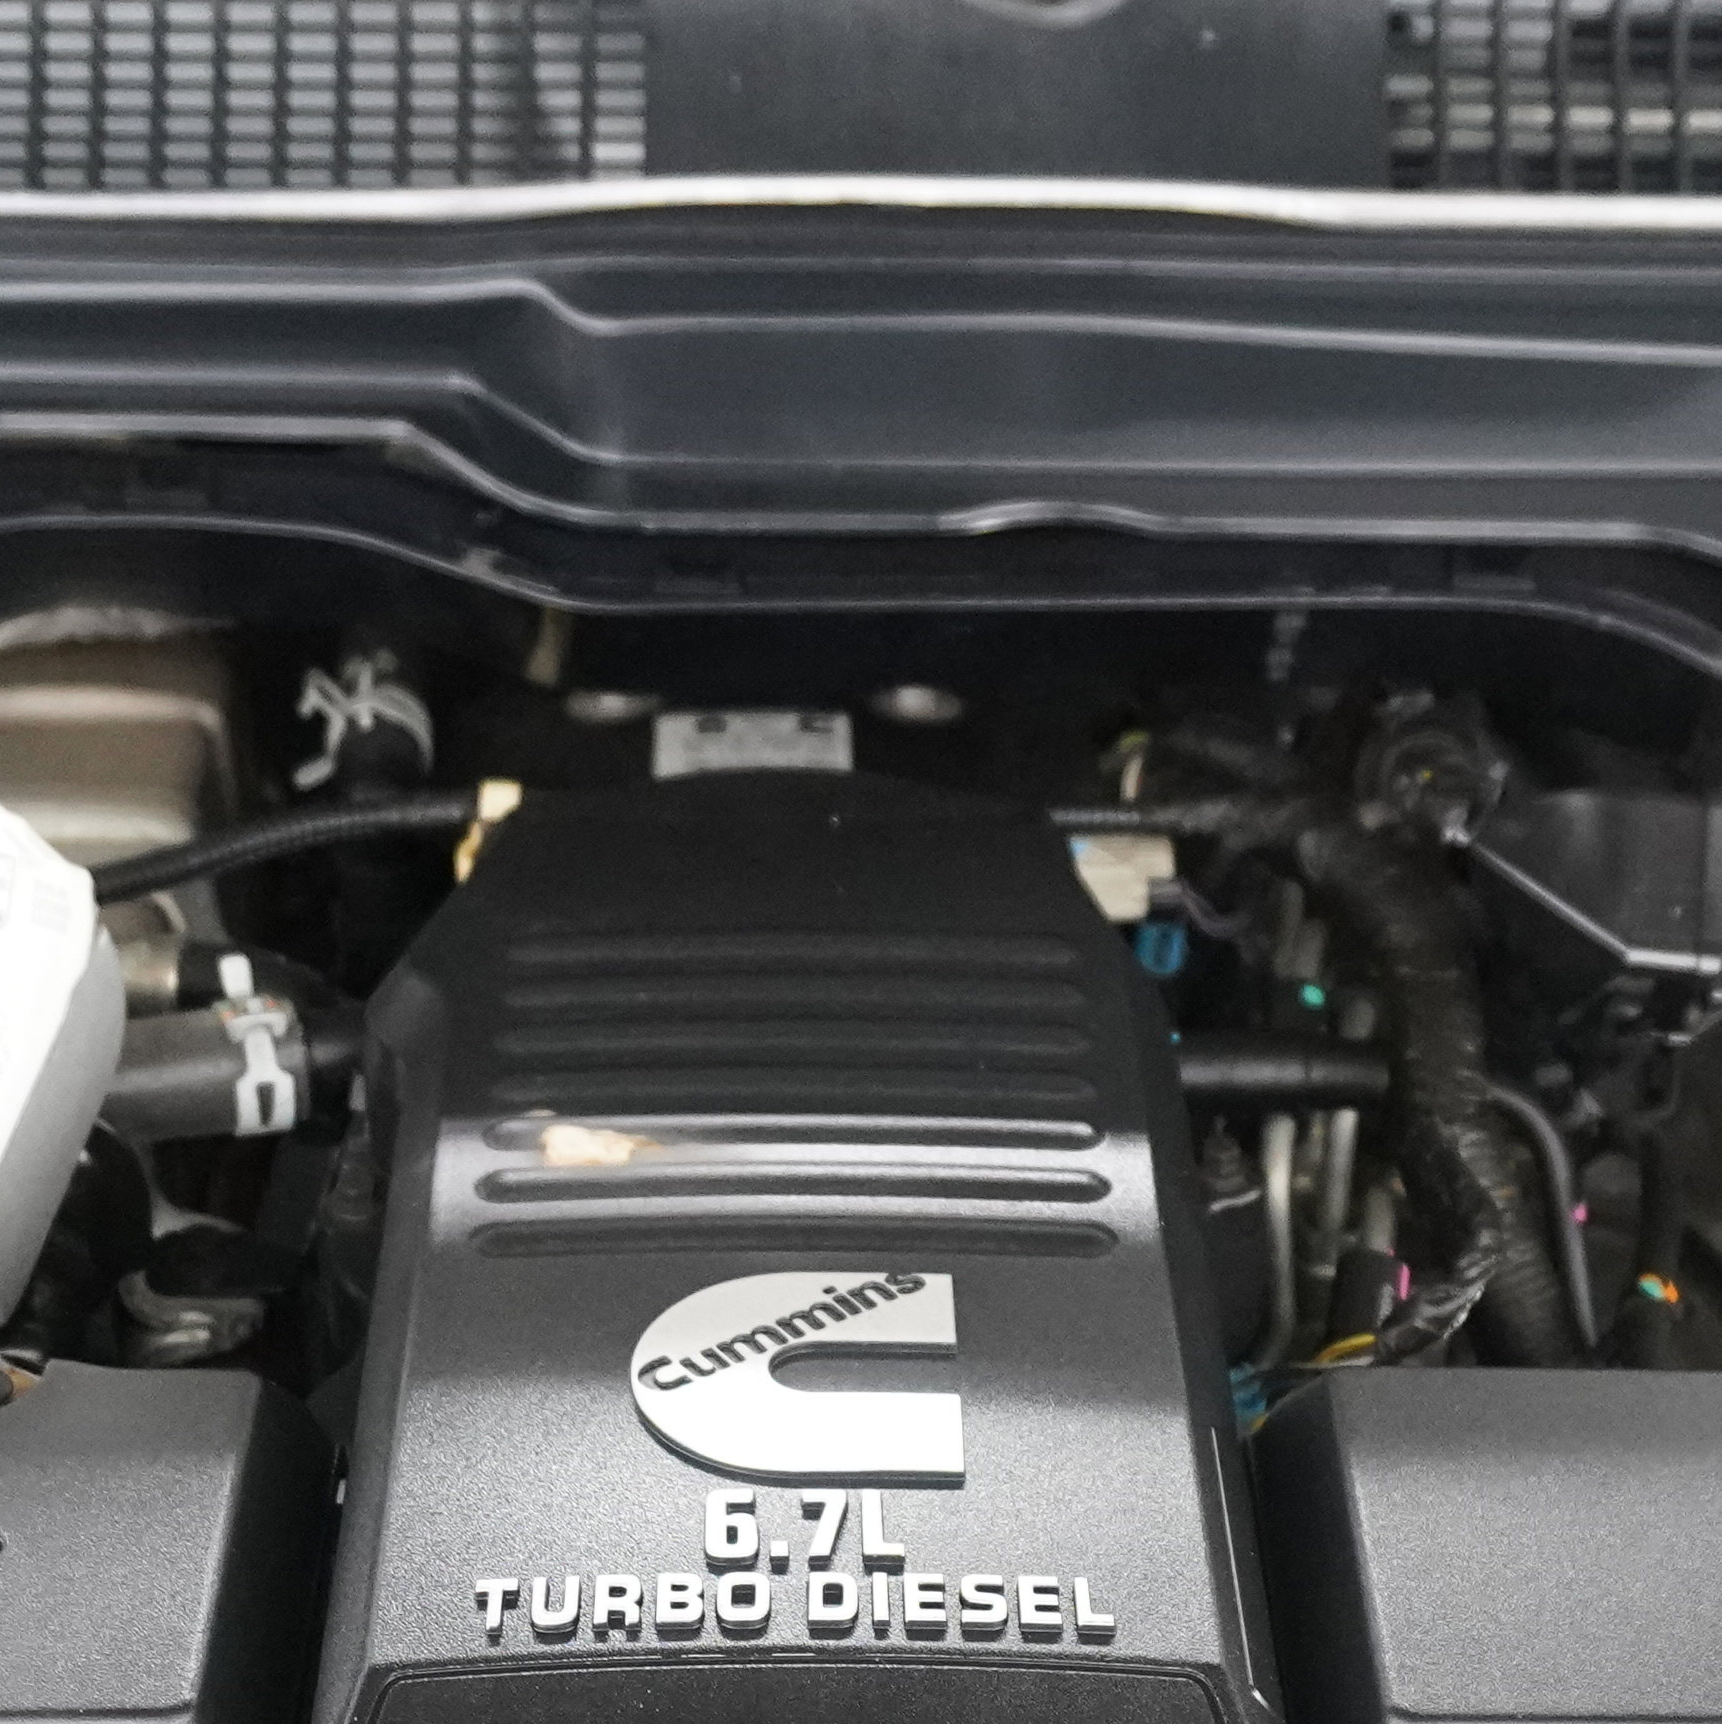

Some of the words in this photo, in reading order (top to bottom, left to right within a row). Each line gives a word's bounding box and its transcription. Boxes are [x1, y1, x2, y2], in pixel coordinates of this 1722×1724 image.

[637, 1271, 926, 1392] Cummins
[704, 1487, 906, 1568] 6.7L
[475, 1572, 771, 1637] TURBO
[807, 1572, 1115, 1638] DIESEL
